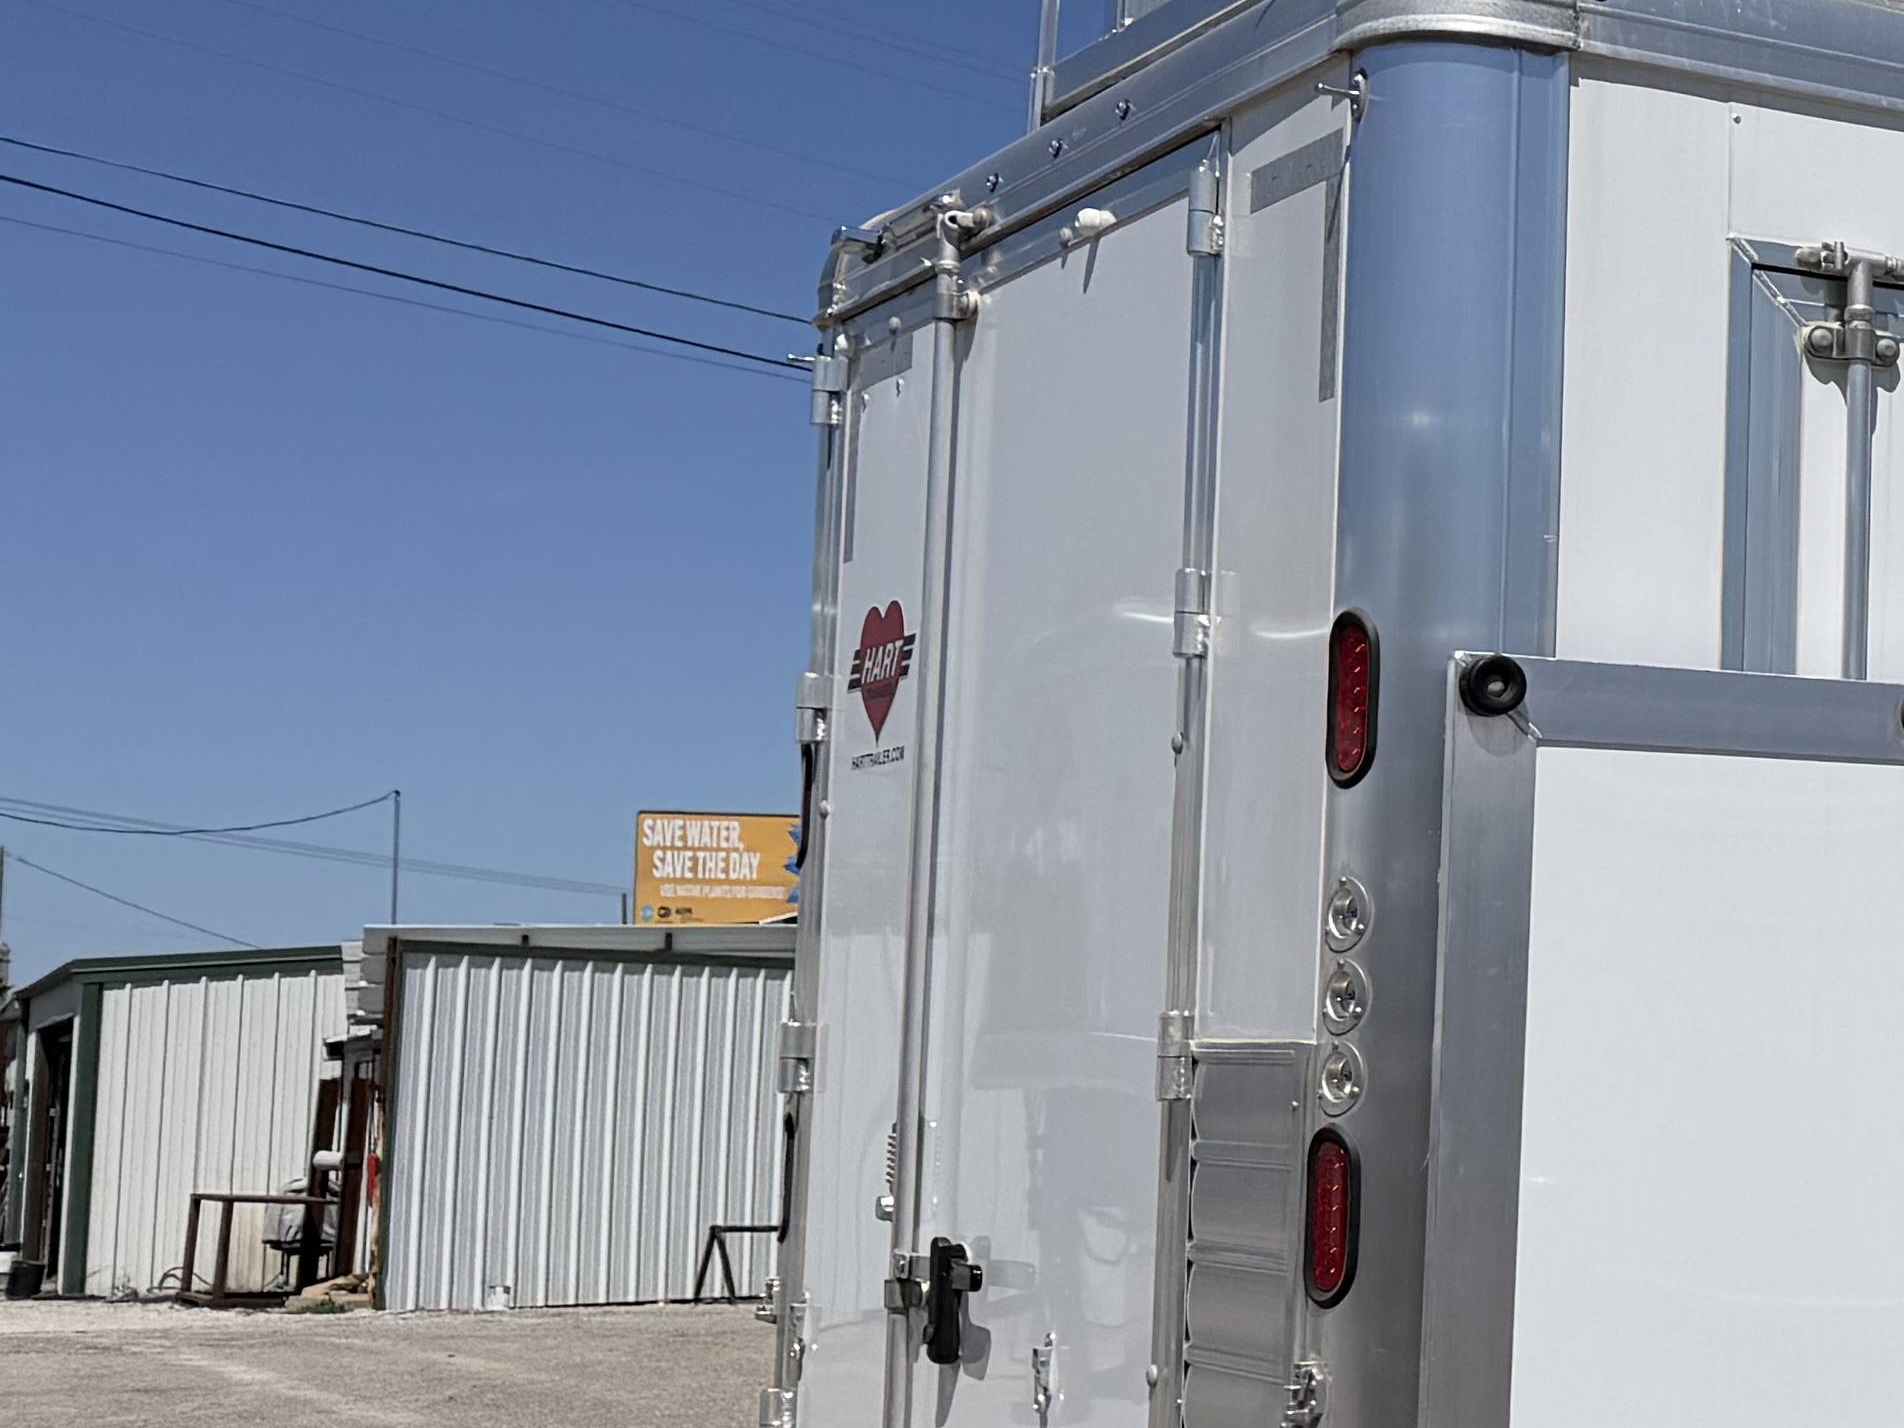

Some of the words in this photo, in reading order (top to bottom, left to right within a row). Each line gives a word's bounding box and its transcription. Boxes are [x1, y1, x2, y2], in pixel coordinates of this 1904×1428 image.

[861, 639, 904, 685] HART
[643, 819, 684, 847] SAVE
[687, 820, 744, 851] WATER,
[653, 850, 693, 879] SAVE
[696, 851, 726, 879] THE
[729, 852, 760, 880] DAY
